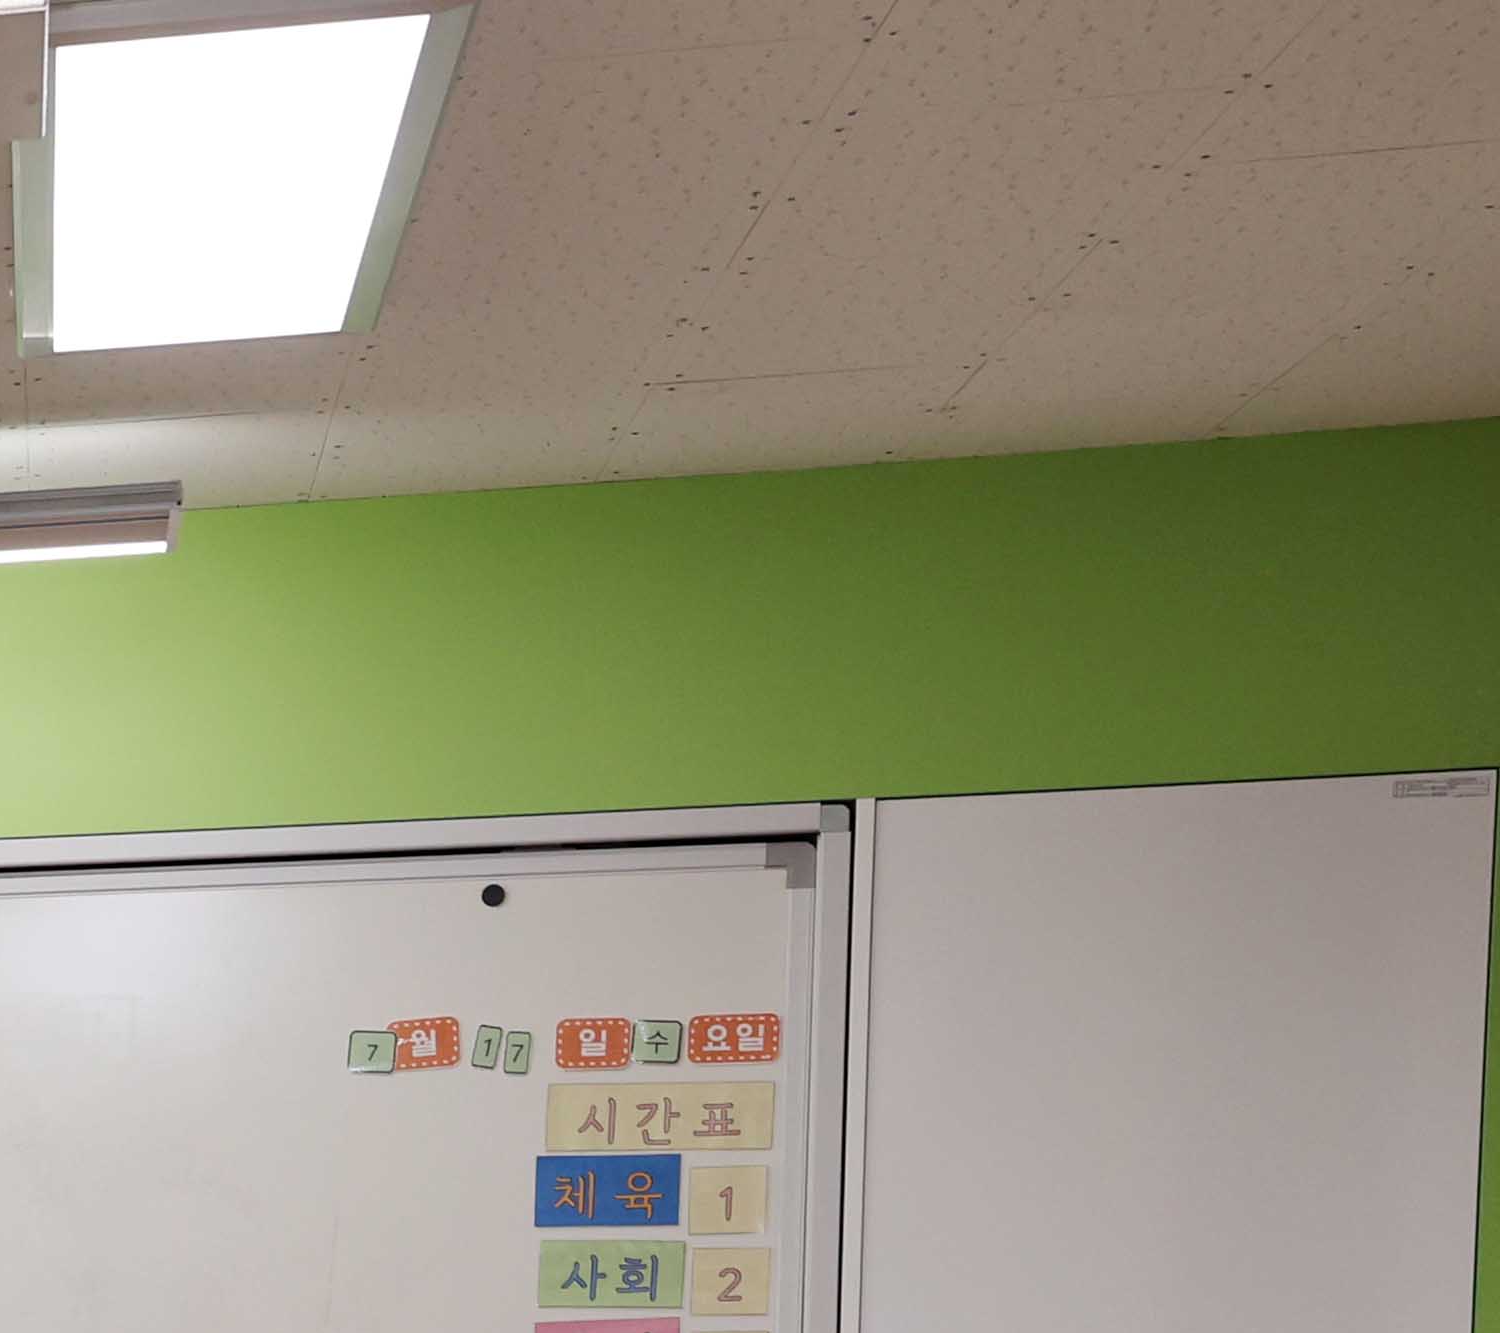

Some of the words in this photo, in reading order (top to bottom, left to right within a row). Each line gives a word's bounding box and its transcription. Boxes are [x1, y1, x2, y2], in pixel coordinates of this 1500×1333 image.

[411, 1029, 438, 1058] 월
[580, 1028, 608, 1058] 일
[644, 1030, 670, 1056] 수
[702, 1024, 765, 1052] 요일
[578, 1097, 741, 1146] 시간표
[554, 1170, 663, 1220] 체육
[718, 1185, 734, 1221] 1
[561, 1254, 659, 1301] 사회
[717, 1267, 743, 1302] 2
